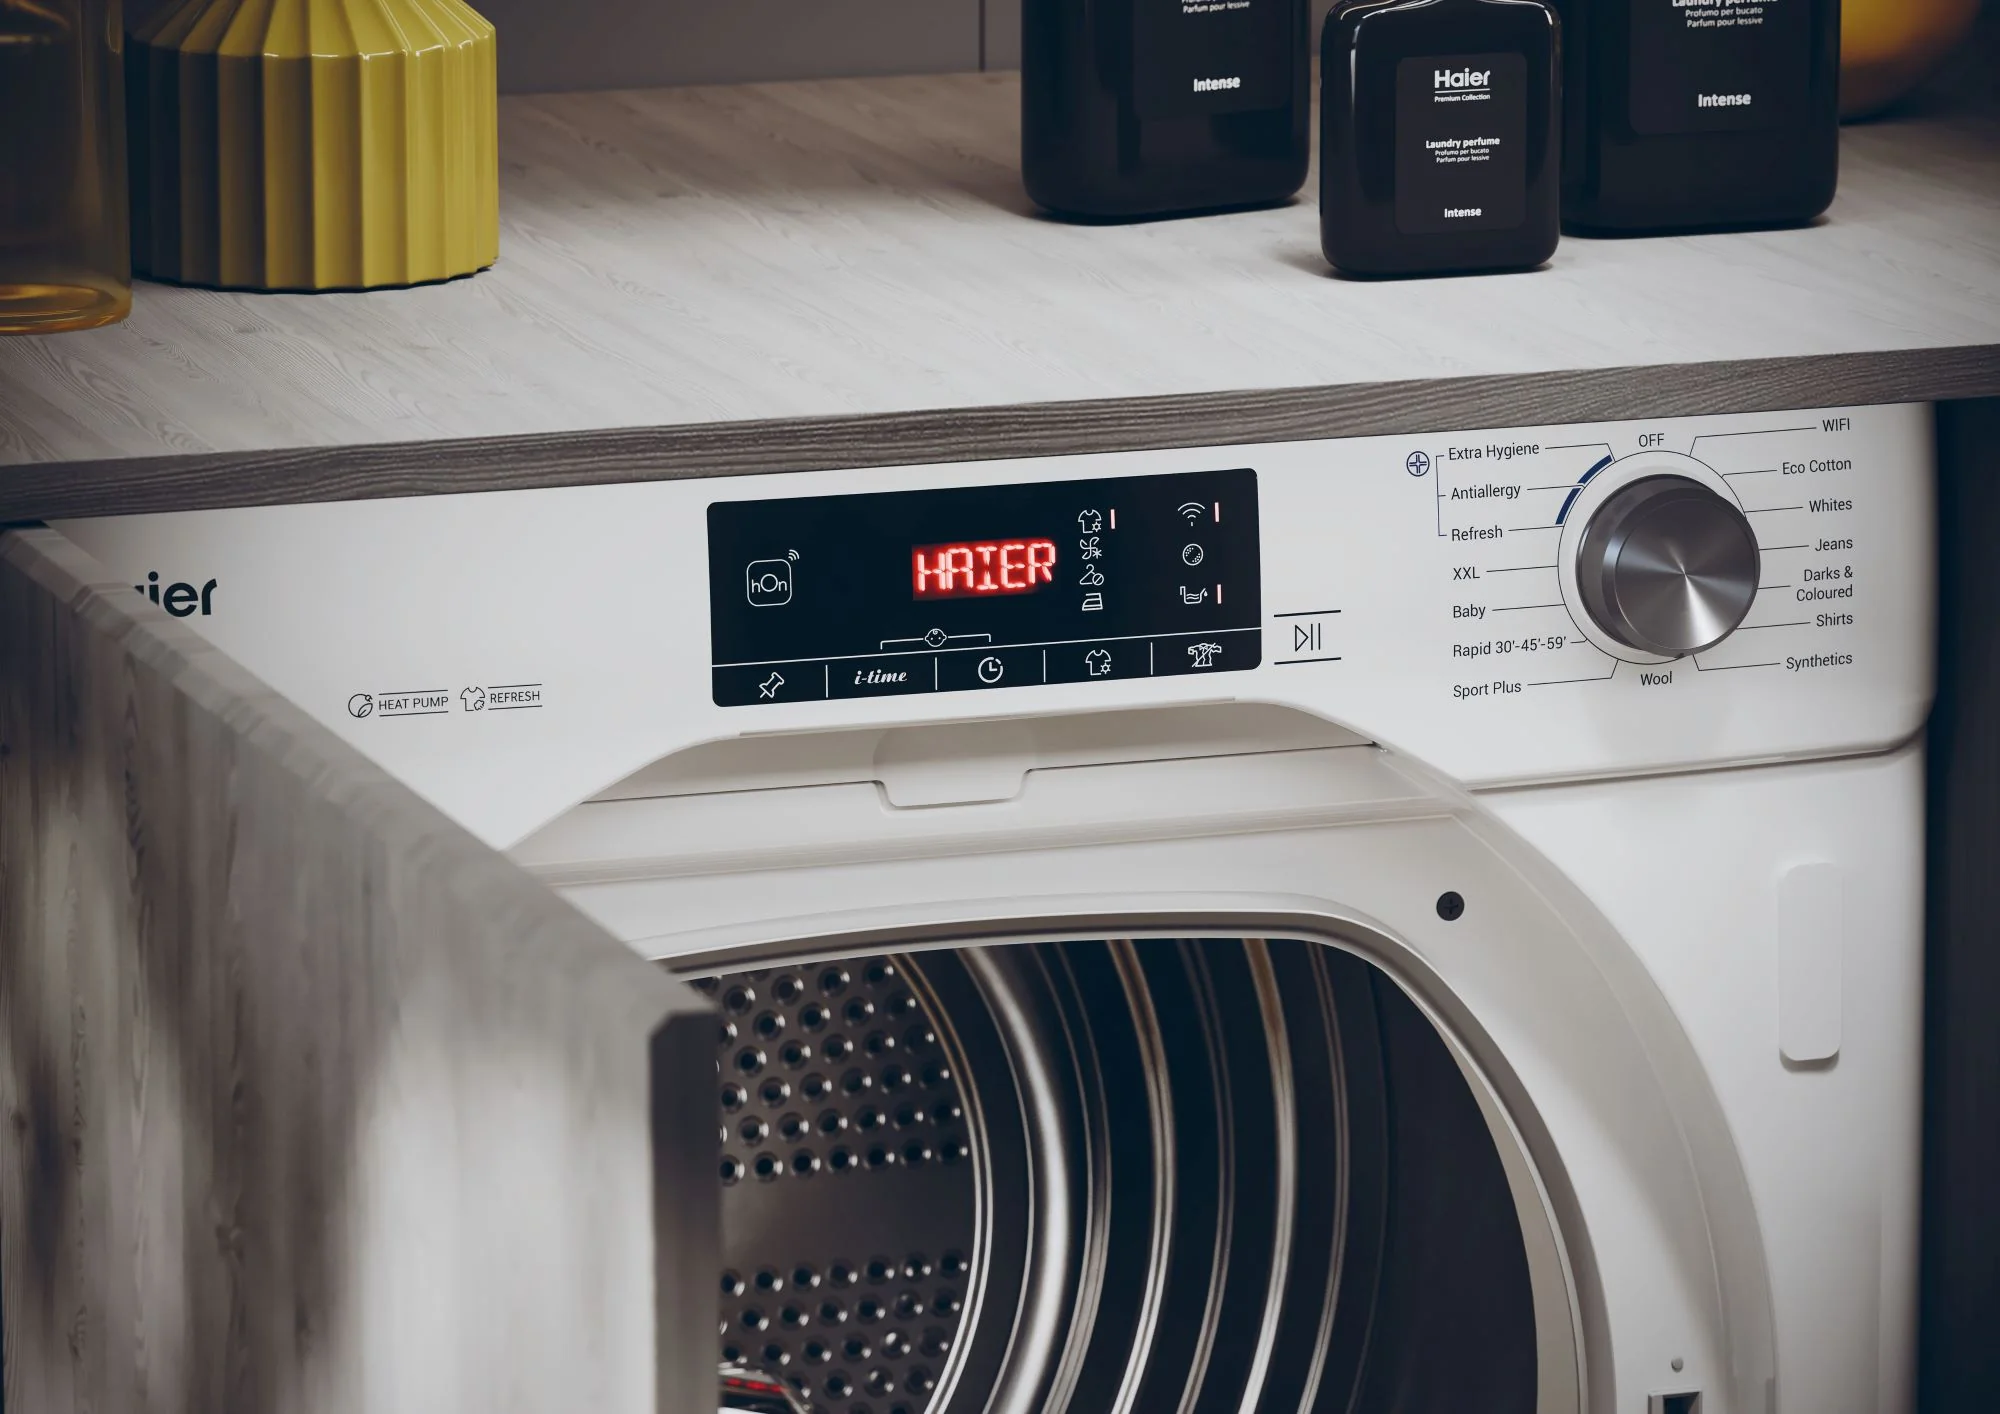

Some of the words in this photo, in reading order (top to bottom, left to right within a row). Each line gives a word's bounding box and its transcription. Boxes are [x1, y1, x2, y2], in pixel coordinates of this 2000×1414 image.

[1686, 9, 1719, 17] Profumo
[1736, 7, 1763, 15] bucato
[1687, 19, 1715, 27] Parfum
[1717, 19, 1735, 27] pour
[1737, 17, 1763, 25] lessive
[1194, 77, 1240, 92] Intense
[1435, 68, 1490, 88] Haier
[1698, 94, 1751, 107] Intense
[1426, 139, 1461, 148] Laundry
[1463, 137, 1500, 148] perfume
[1445, 209, 1481, 217] Intense
[1823, 418, 1849, 431] WIFI
[1638, 433, 1665, 448] OFF
[1449, 448, 1481, 460] Extra
[1487, 443, 1539, 460] Hygiene
[1783, 462, 1805, 474] Eco
[1810, 460, 1851, 472] Cotton
[1452, 484, 1520, 499] Antiallergy
[1809, 498, 1852, 512] Whites
[1452, 526, 1502, 541] Refresh
[1815, 539, 1852, 551] Jeans
[916, 542, 1056, 592] HAIER
[1453, 567, 1481, 580] XXL
[1804, 567, 1840, 581] Darks
[1844, 566, 1852, 578] &
[751, 573, 788, 593] hOn
[134, 571, 217, 617] ier
[1797, 584, 1852, 601] Coloured
[1454, 604, 1485, 619] Baby
[1817, 613, 1853, 626] Shirts
[1454, 642, 1490, 658] Rapid
[1787, 652, 1852, 672] Synthetics
[855, 669, 907, 684] i-time
[1641, 671, 1672, 685] Wool
[490, 690, 541, 703] REFRESH
[1454, 684, 1488, 700] Sport
[1494, 681, 1521, 694] Plus
[379, 699, 409, 710] HEAT
[413, 697, 448, 708] PUMP
